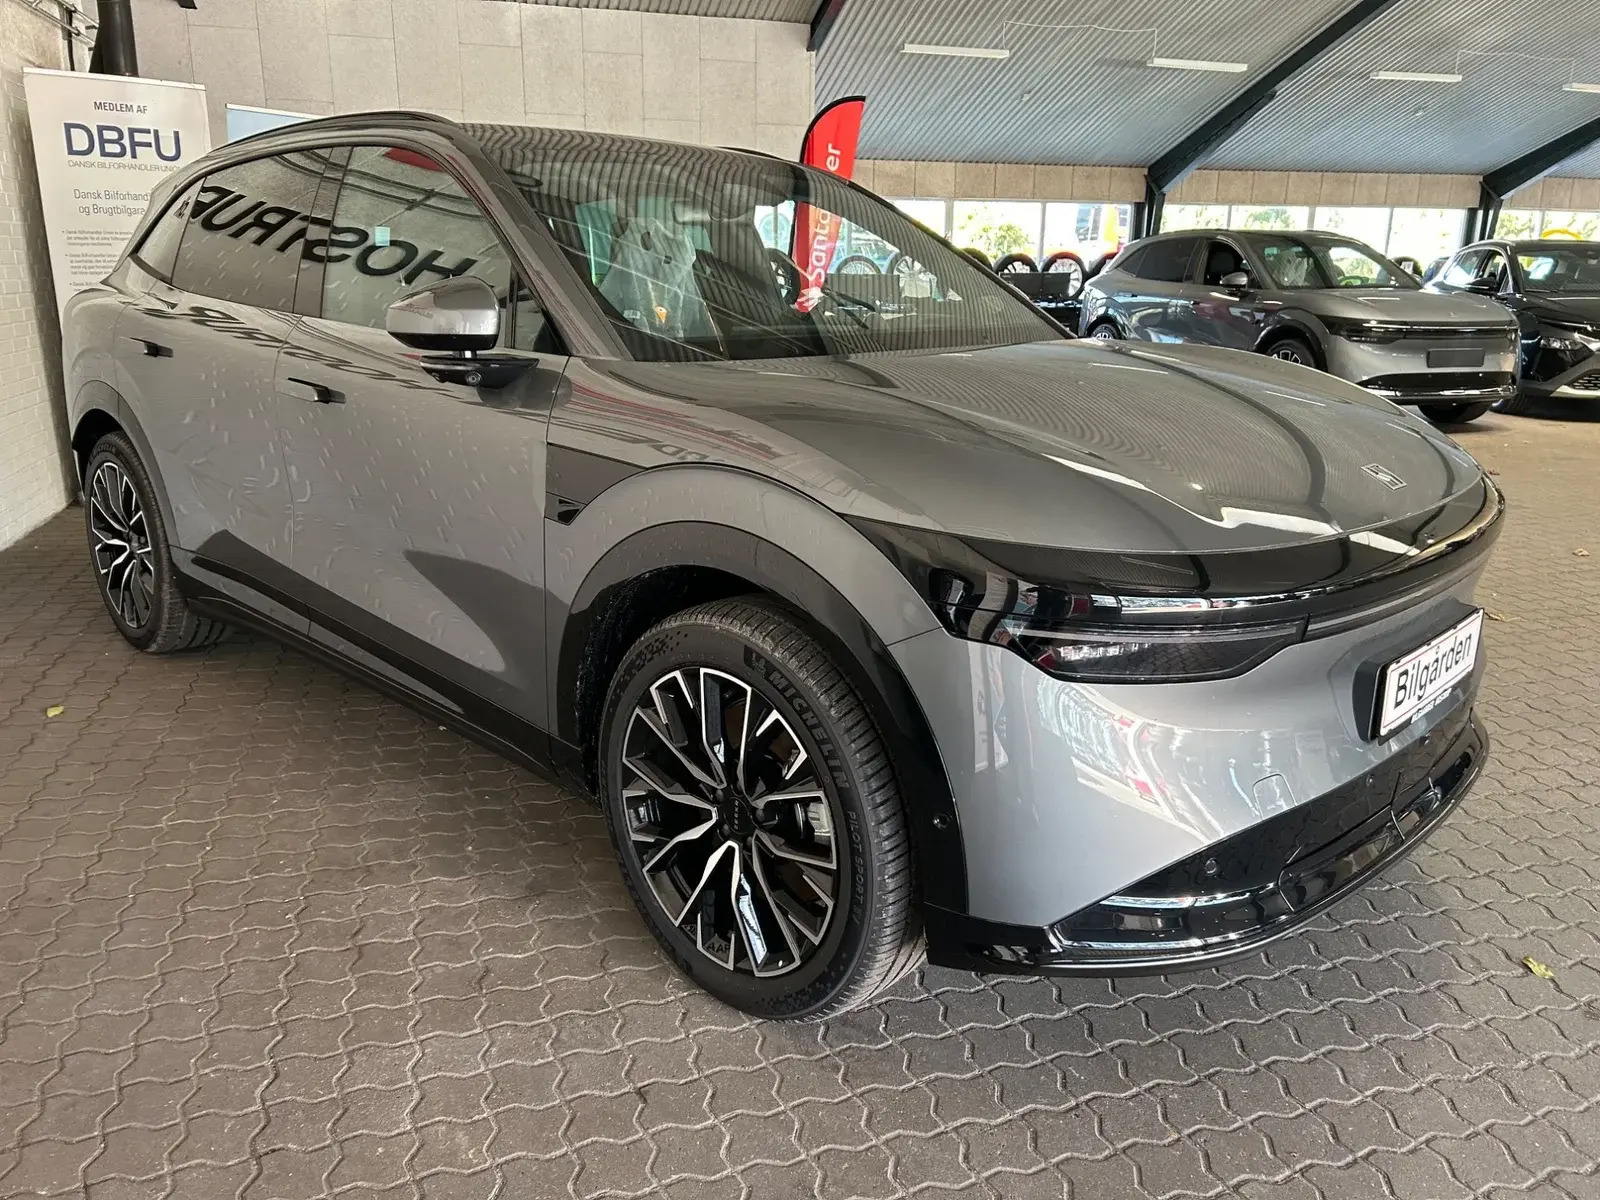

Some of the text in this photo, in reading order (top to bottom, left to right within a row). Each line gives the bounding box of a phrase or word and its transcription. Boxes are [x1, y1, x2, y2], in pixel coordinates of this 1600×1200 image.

[94, 101, 148, 115] MEDLEM AF
[63, 122, 182, 161] DBFU
[67, 160, 97, 169] DANSK
[73, 189, 103, 200] Dansk
[79, 205, 90, 216] og
[1394, 633, 1472, 710] Bilgården
[768, 670, 850, 788] MICHELIN
[846, 810, 862, 853] PILOT
[854, 855, 864, 904] SPORT
